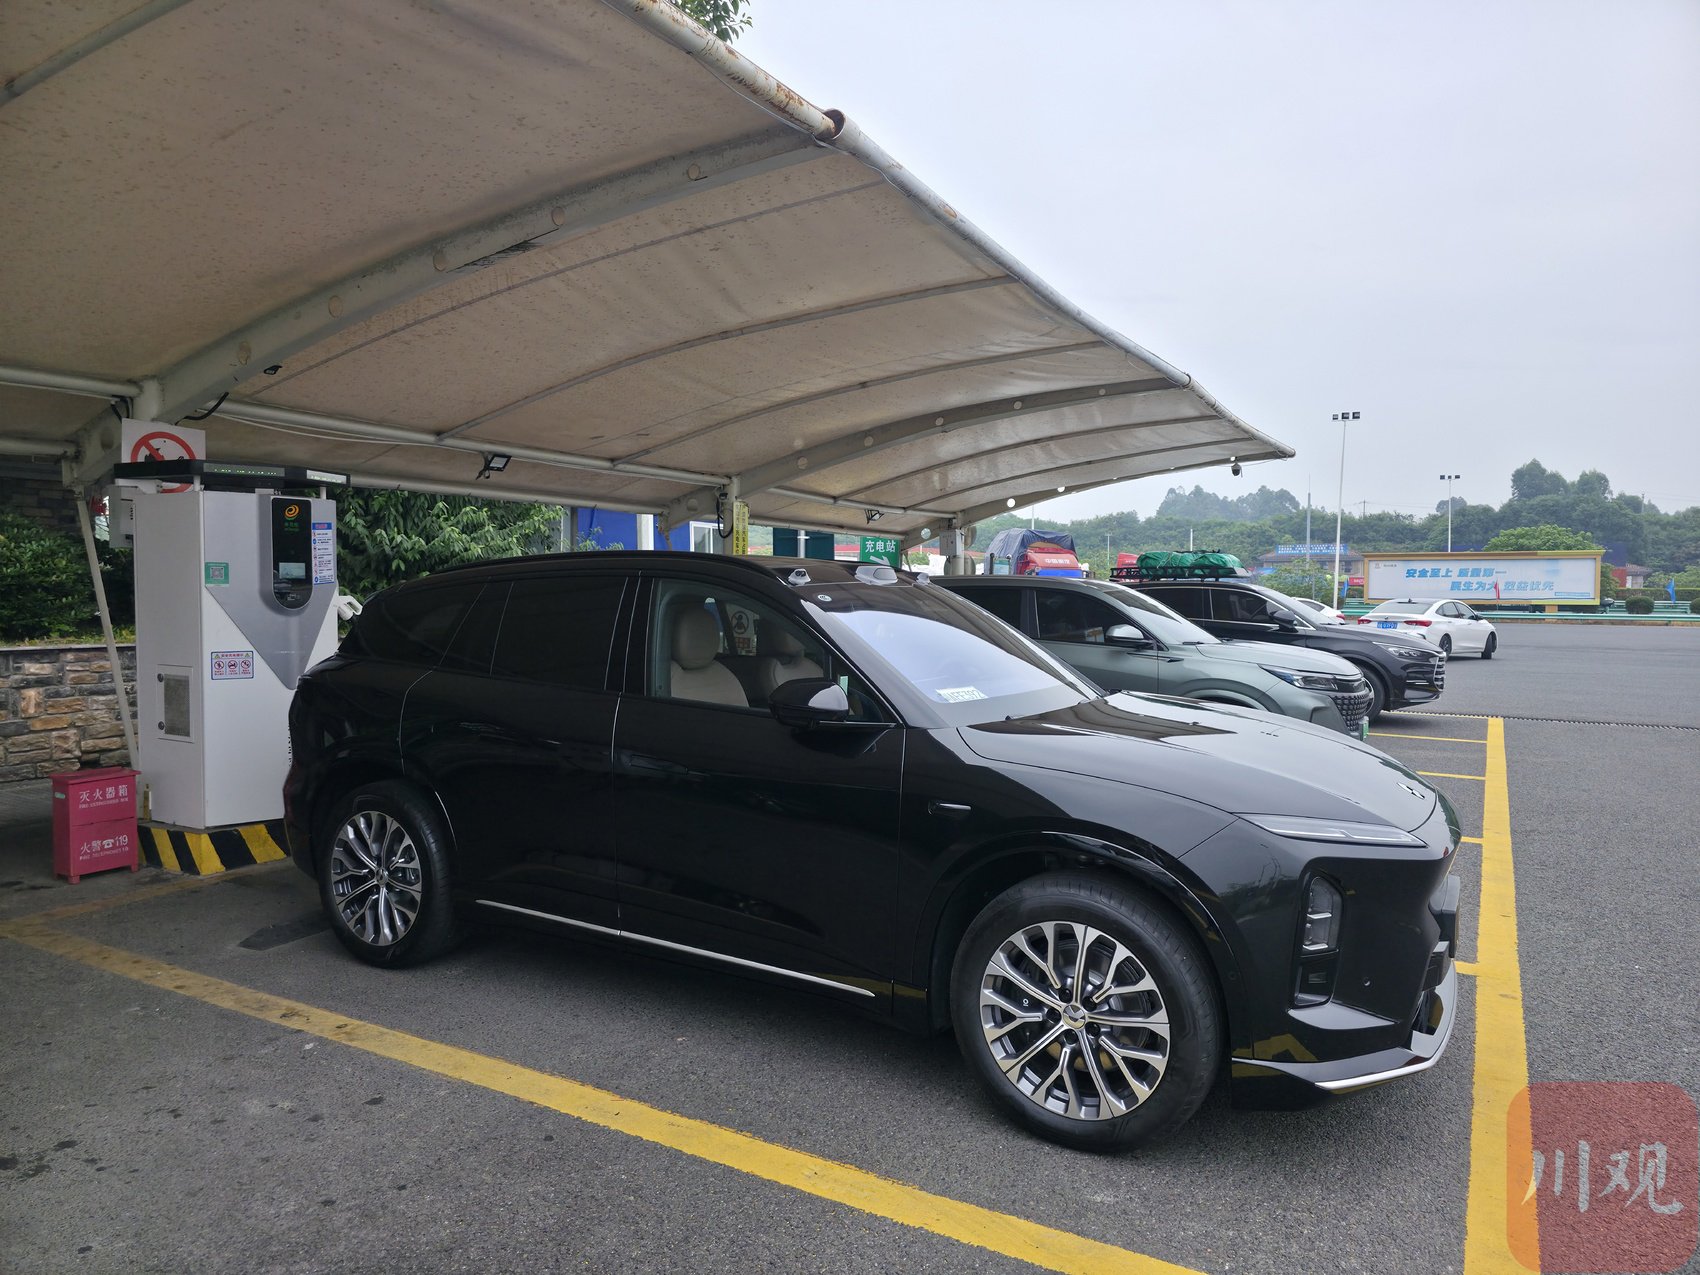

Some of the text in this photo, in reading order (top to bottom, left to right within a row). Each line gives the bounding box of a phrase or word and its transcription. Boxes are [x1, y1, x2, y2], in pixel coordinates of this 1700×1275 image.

[865, 540, 897, 553] 充电站
[1405, 568, 1453, 578] 安全至上
[79, 785, 128, 803] 灭火器箱
[81, 834, 129, 854] 火警 119
